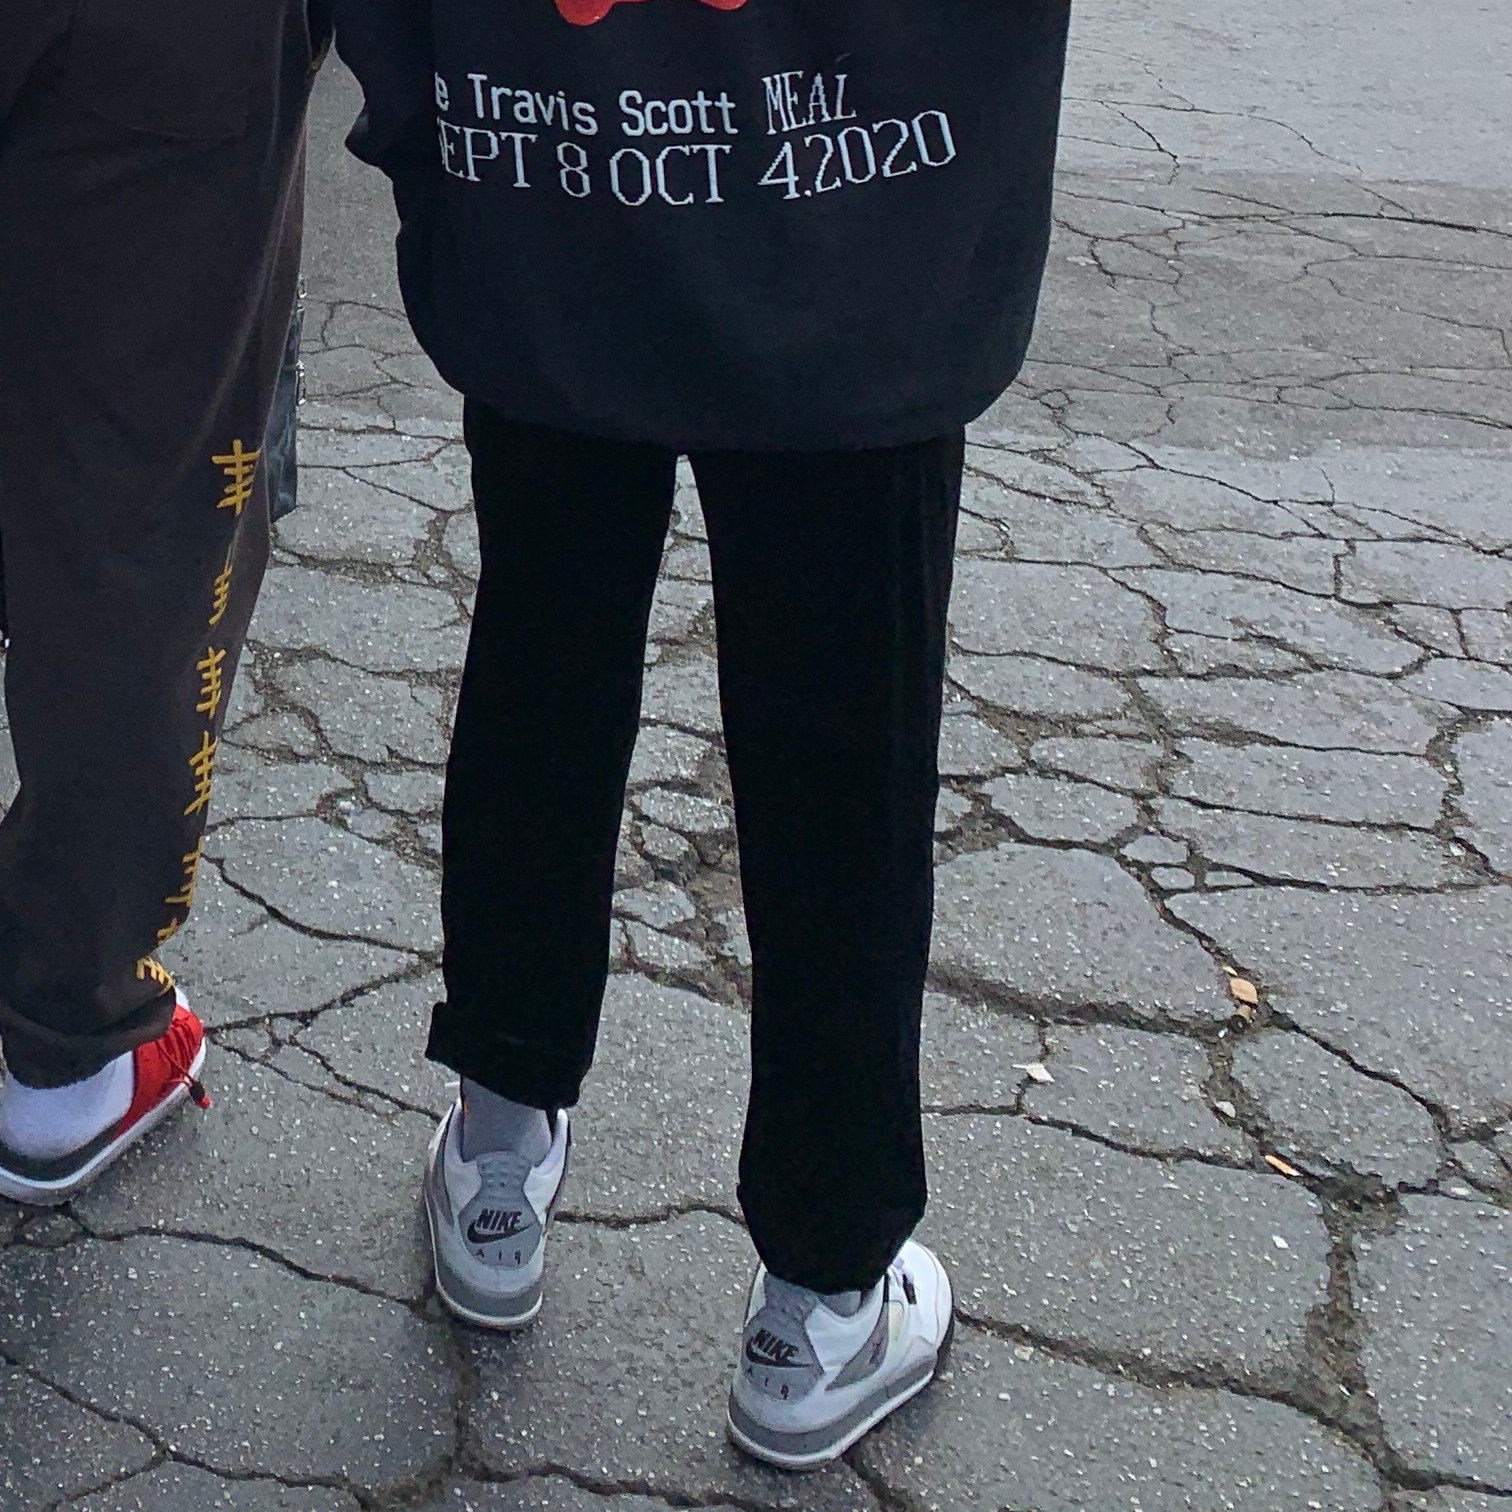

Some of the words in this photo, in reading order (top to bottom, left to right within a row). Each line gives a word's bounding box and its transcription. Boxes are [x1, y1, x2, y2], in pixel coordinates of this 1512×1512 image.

[466, 72, 598, 136] Travis
[618, 89, 739, 136] Scott
[761, 70, 857, 135] MEAL
[436, 117, 538, 188] EPT
[556, 141, 590, 198] 8
[608, 143, 733, 207] OCT
[476, 1208, 523, 1231] NIKE
[753, 1328, 800, 1361] NIKE
